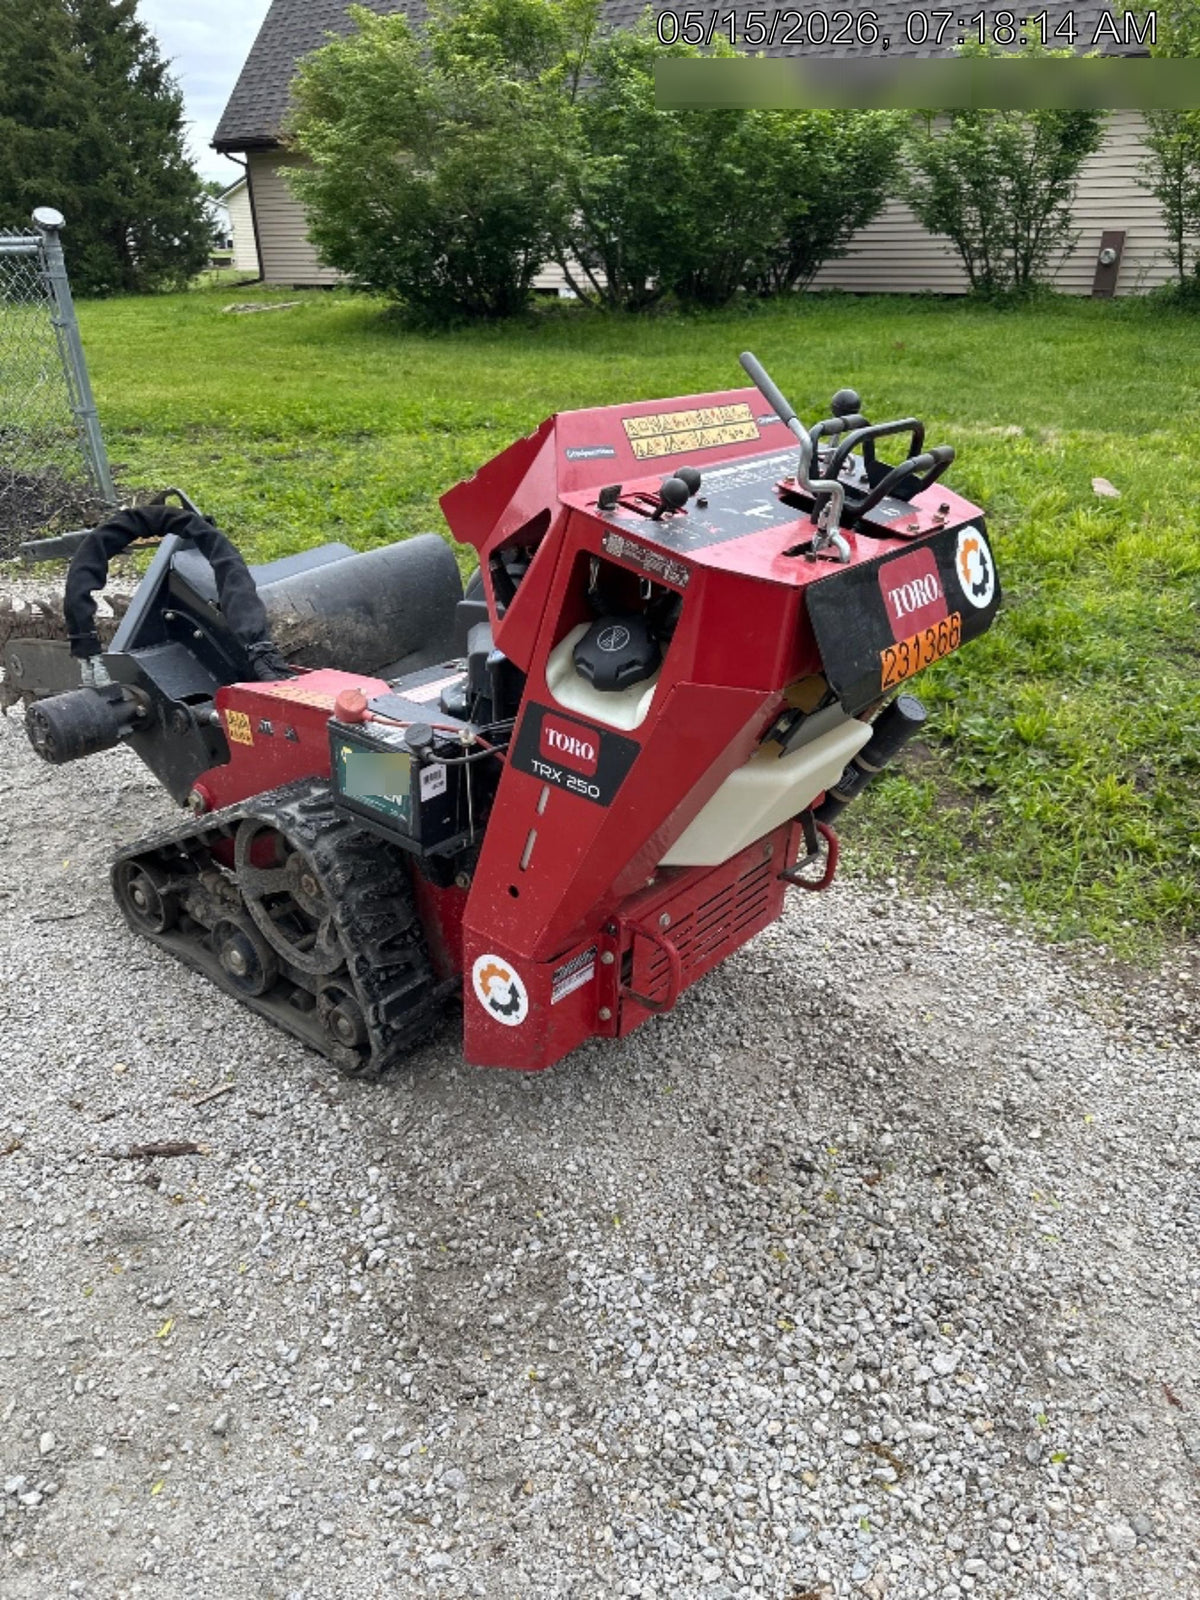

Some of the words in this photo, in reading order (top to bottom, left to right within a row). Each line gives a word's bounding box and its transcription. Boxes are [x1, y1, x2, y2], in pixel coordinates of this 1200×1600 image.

[888, 573, 939, 619] TORO
[883, 614, 960, 687] 231366
[545, 727, 595, 760] TORO
[531, 758, 563, 784] TRX
[566, 774, 601, 799] 250
